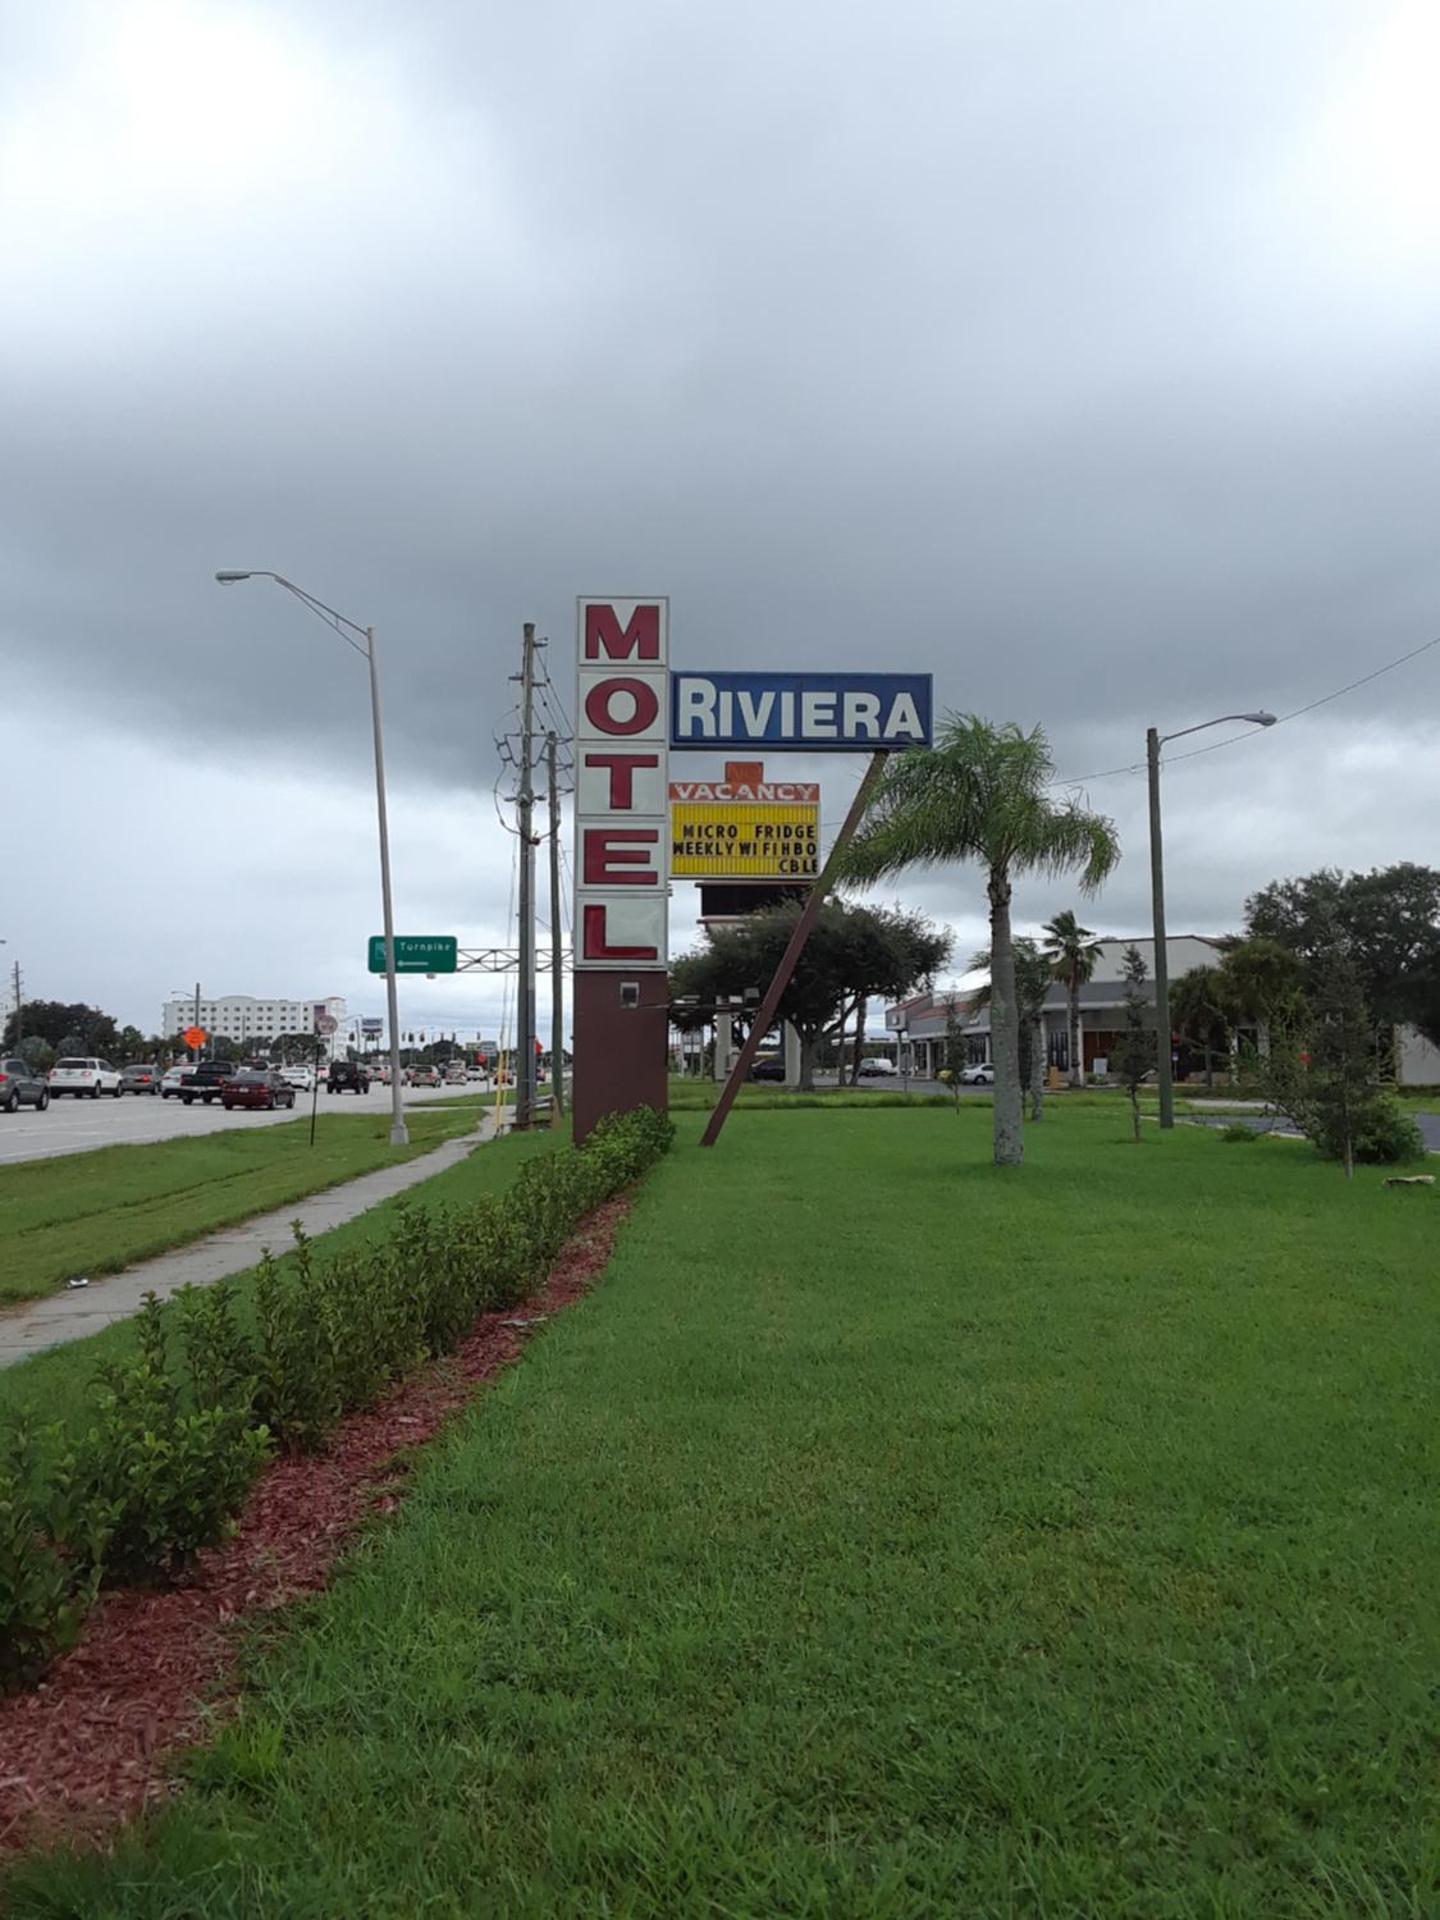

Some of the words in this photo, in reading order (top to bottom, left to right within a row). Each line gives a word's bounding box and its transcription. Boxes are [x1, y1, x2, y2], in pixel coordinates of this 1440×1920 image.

[678, 677, 926, 739] RIVIERA
[584, 604, 660, 961] MOTEL
[674, 783, 817, 800] VACANCY
[683, 824, 738, 839] MICRO
[755, 824, 815, 839] FRIDGE
[673, 842, 734, 856] WEEKLY
[400, 942, 451, 952] Turnpike
